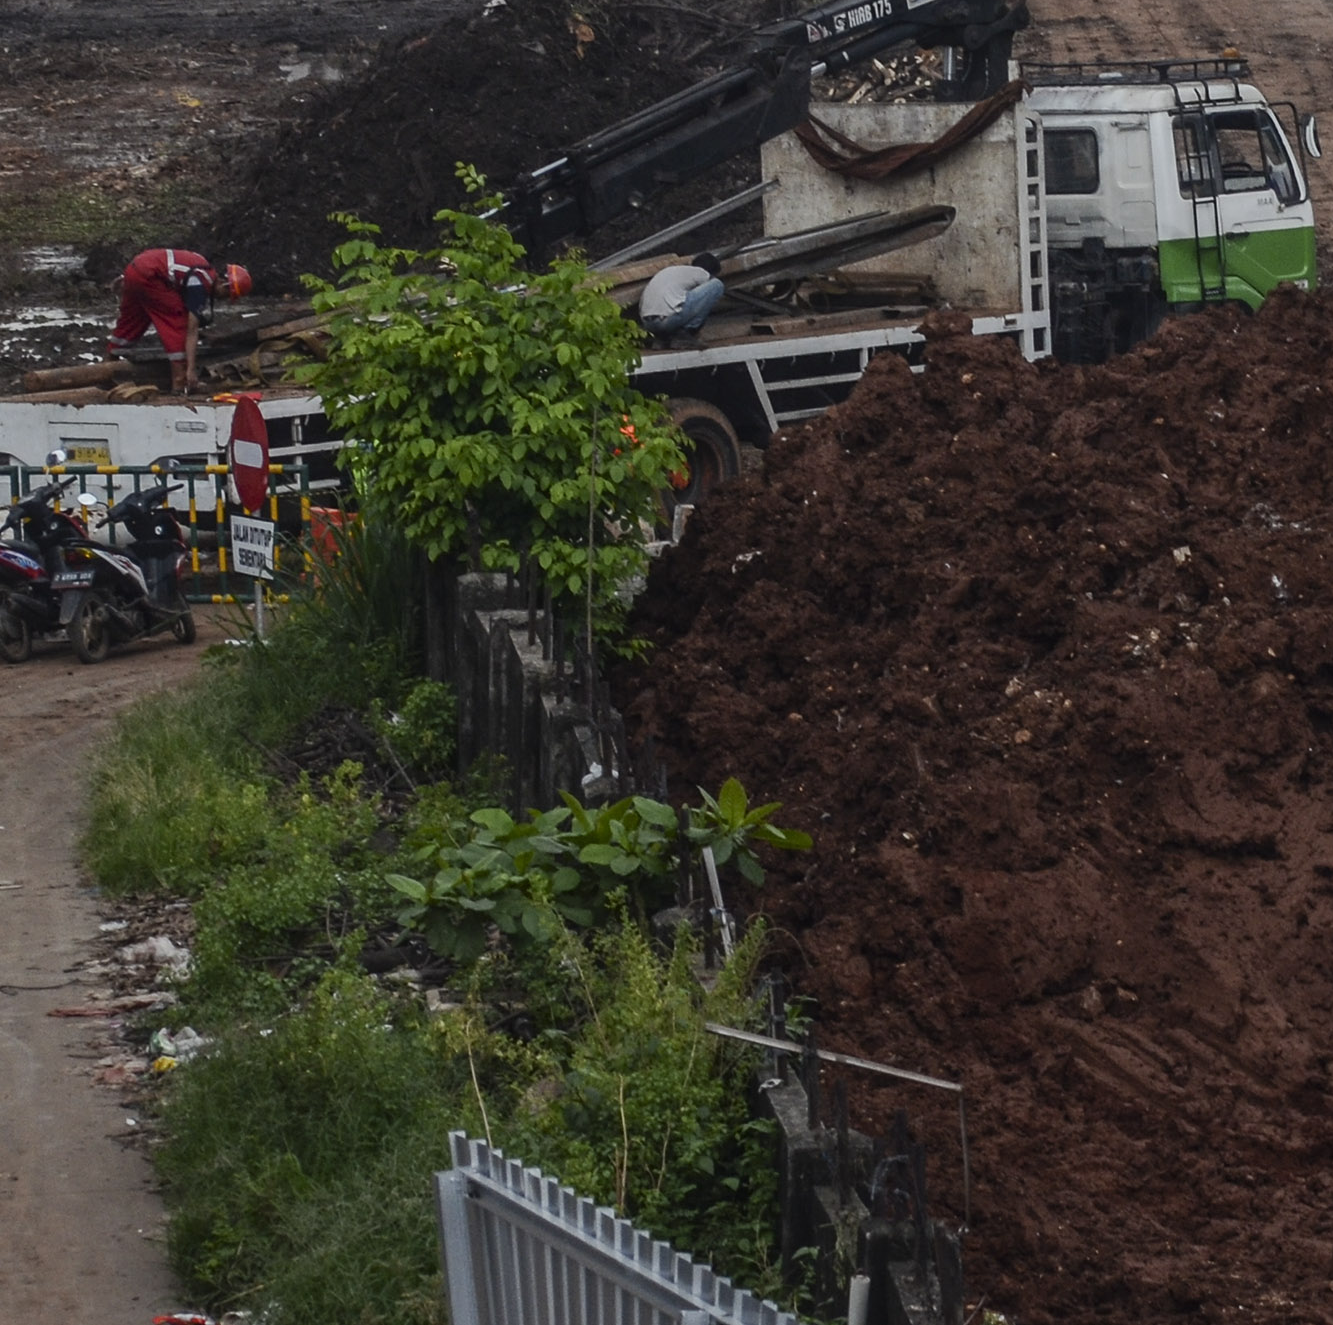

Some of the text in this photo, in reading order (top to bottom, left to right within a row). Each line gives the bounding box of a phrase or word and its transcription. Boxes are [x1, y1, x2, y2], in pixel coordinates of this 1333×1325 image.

[847, 4, 873, 28] HIAB
[233, 524, 272, 547] JALAN DITUTUP
